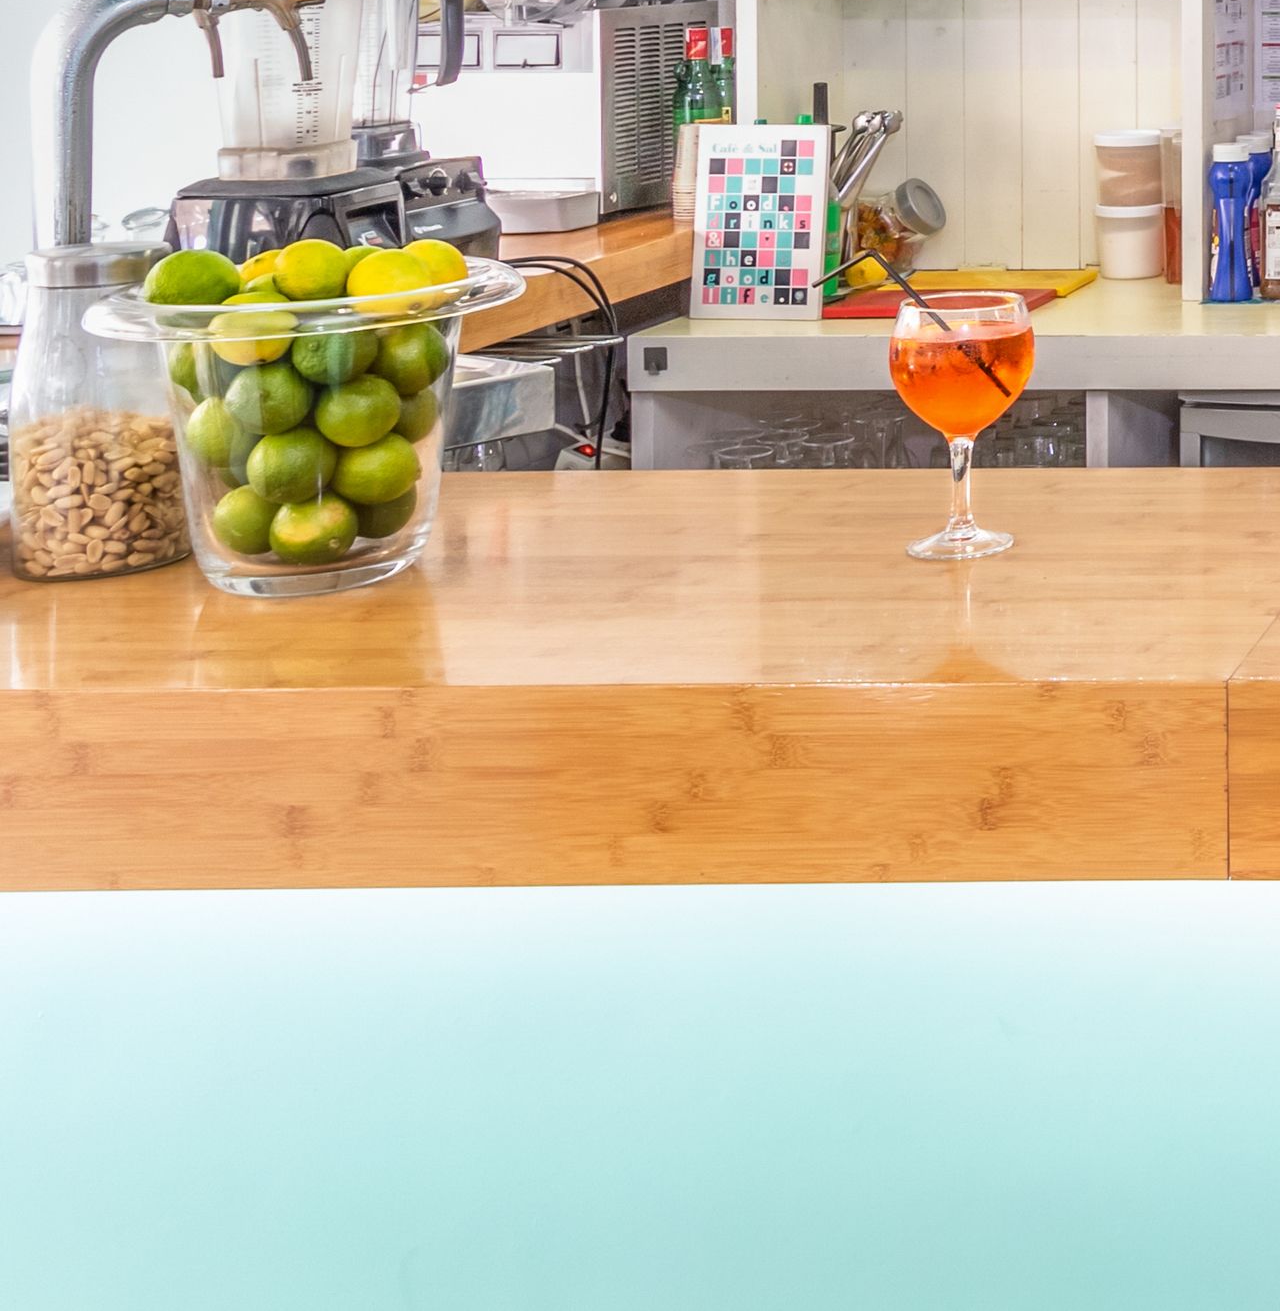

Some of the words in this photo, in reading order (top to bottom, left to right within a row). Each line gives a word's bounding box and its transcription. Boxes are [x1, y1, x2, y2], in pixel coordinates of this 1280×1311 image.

[759, 143, 777, 154] Sal
[709, 214, 806, 230] drinks
[708, 232, 721, 246] &
[711, 251, 754, 267] the
[706, 269, 770, 287] good
